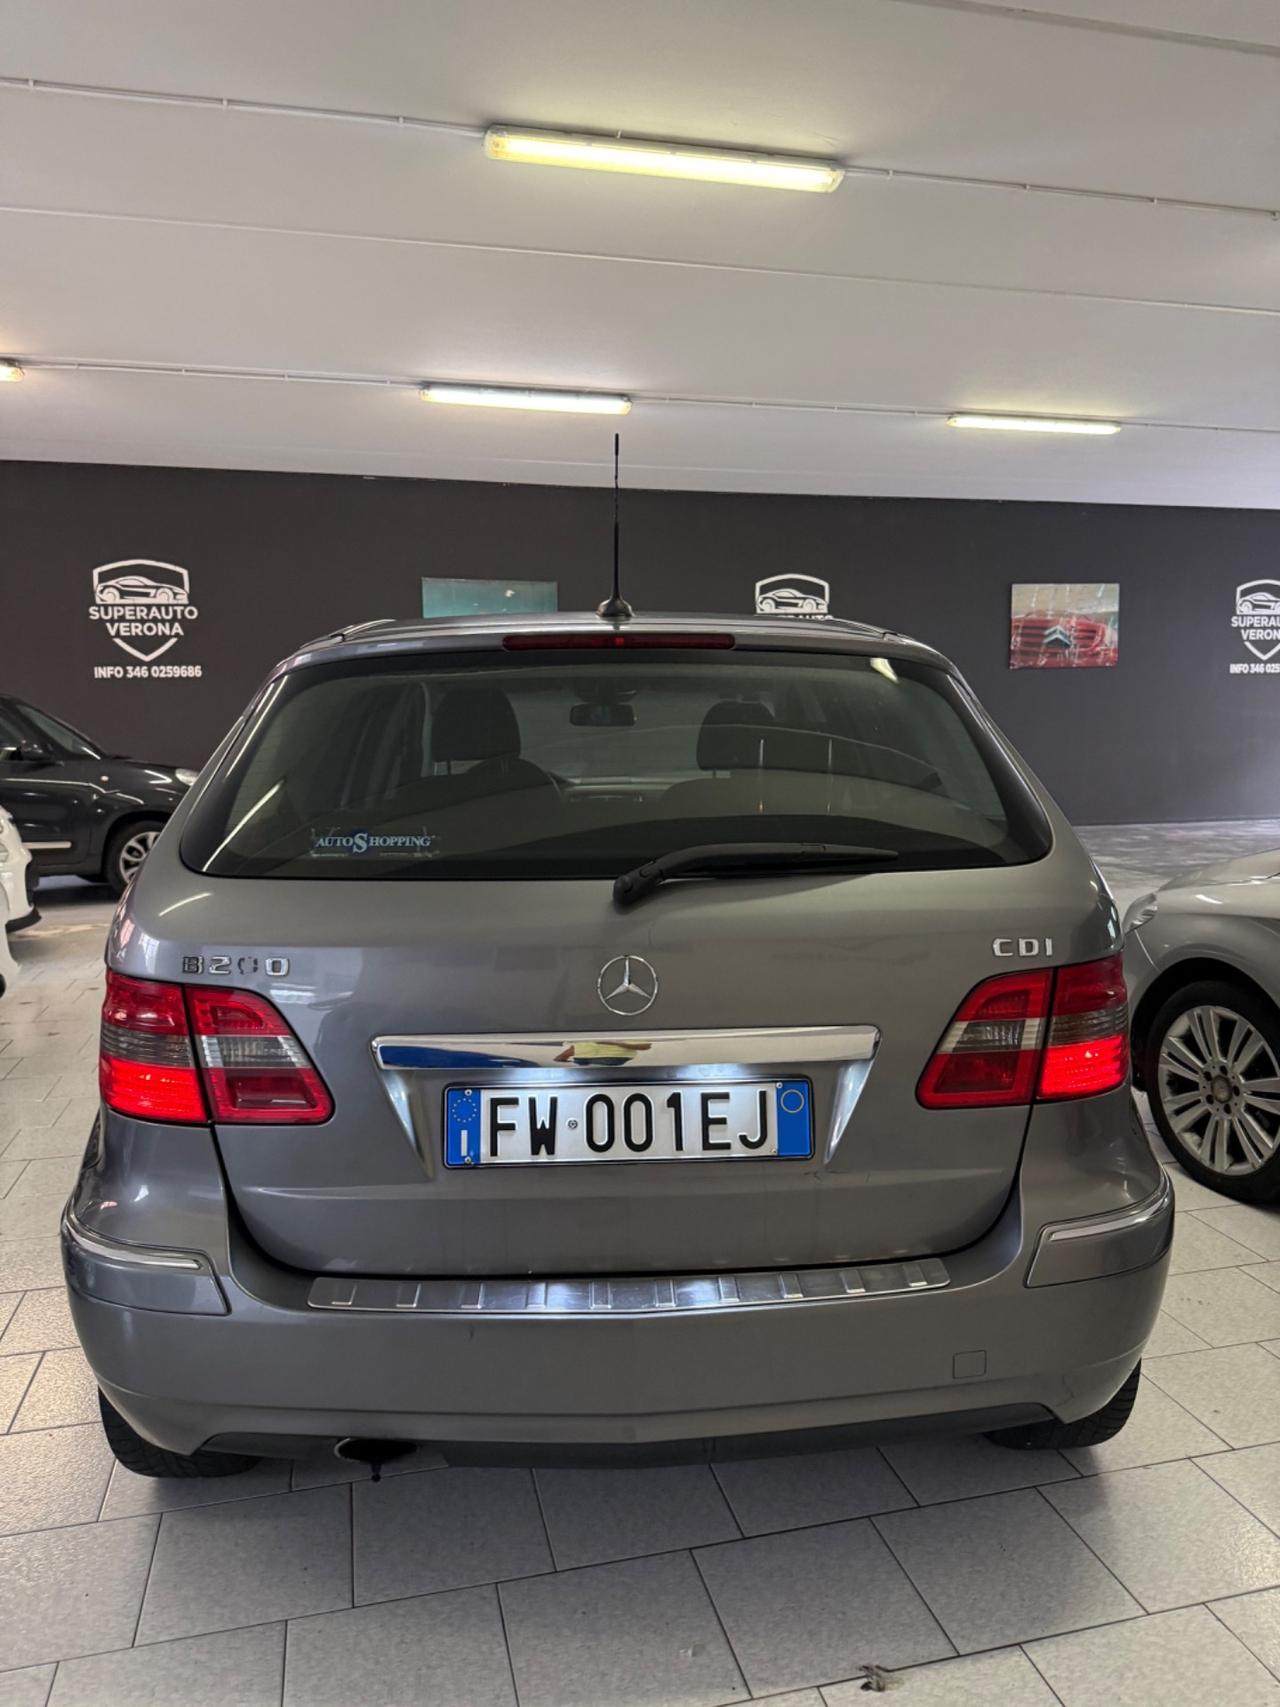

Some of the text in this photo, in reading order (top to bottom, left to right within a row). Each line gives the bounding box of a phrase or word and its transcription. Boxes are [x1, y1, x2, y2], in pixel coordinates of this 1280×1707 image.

[88, 605, 199, 620] SUPERAUTO
[105, 622, 185, 636] VERONA
[94, 665, 202, 678] INFO 346 0259686
[1229, 663, 1249, 674] INFO
[1250, 663, 1265, 673] 346
[992, 937, 1053, 957] CDI
[489, 1096, 559, 1158] FW
